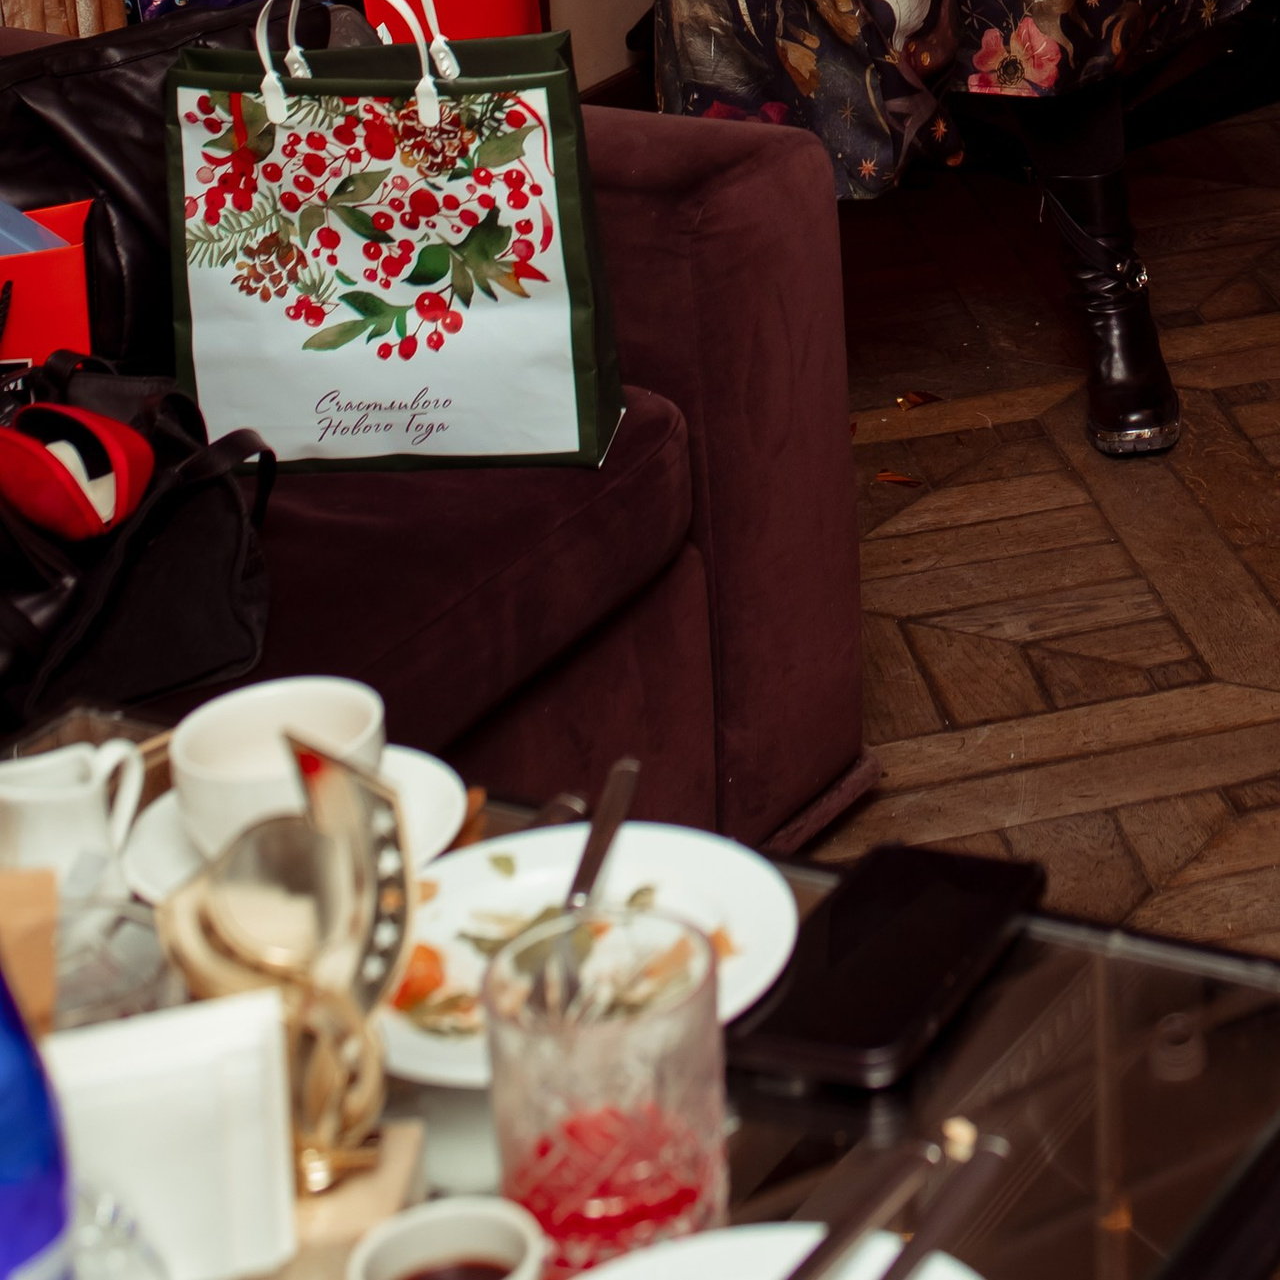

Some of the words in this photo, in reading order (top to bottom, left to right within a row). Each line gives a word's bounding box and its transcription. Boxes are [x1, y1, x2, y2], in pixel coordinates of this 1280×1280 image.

[315, 386, 452, 414] Счастливого
[317, 412, 394, 442] Нового
[405, 412, 451, 445] Года
